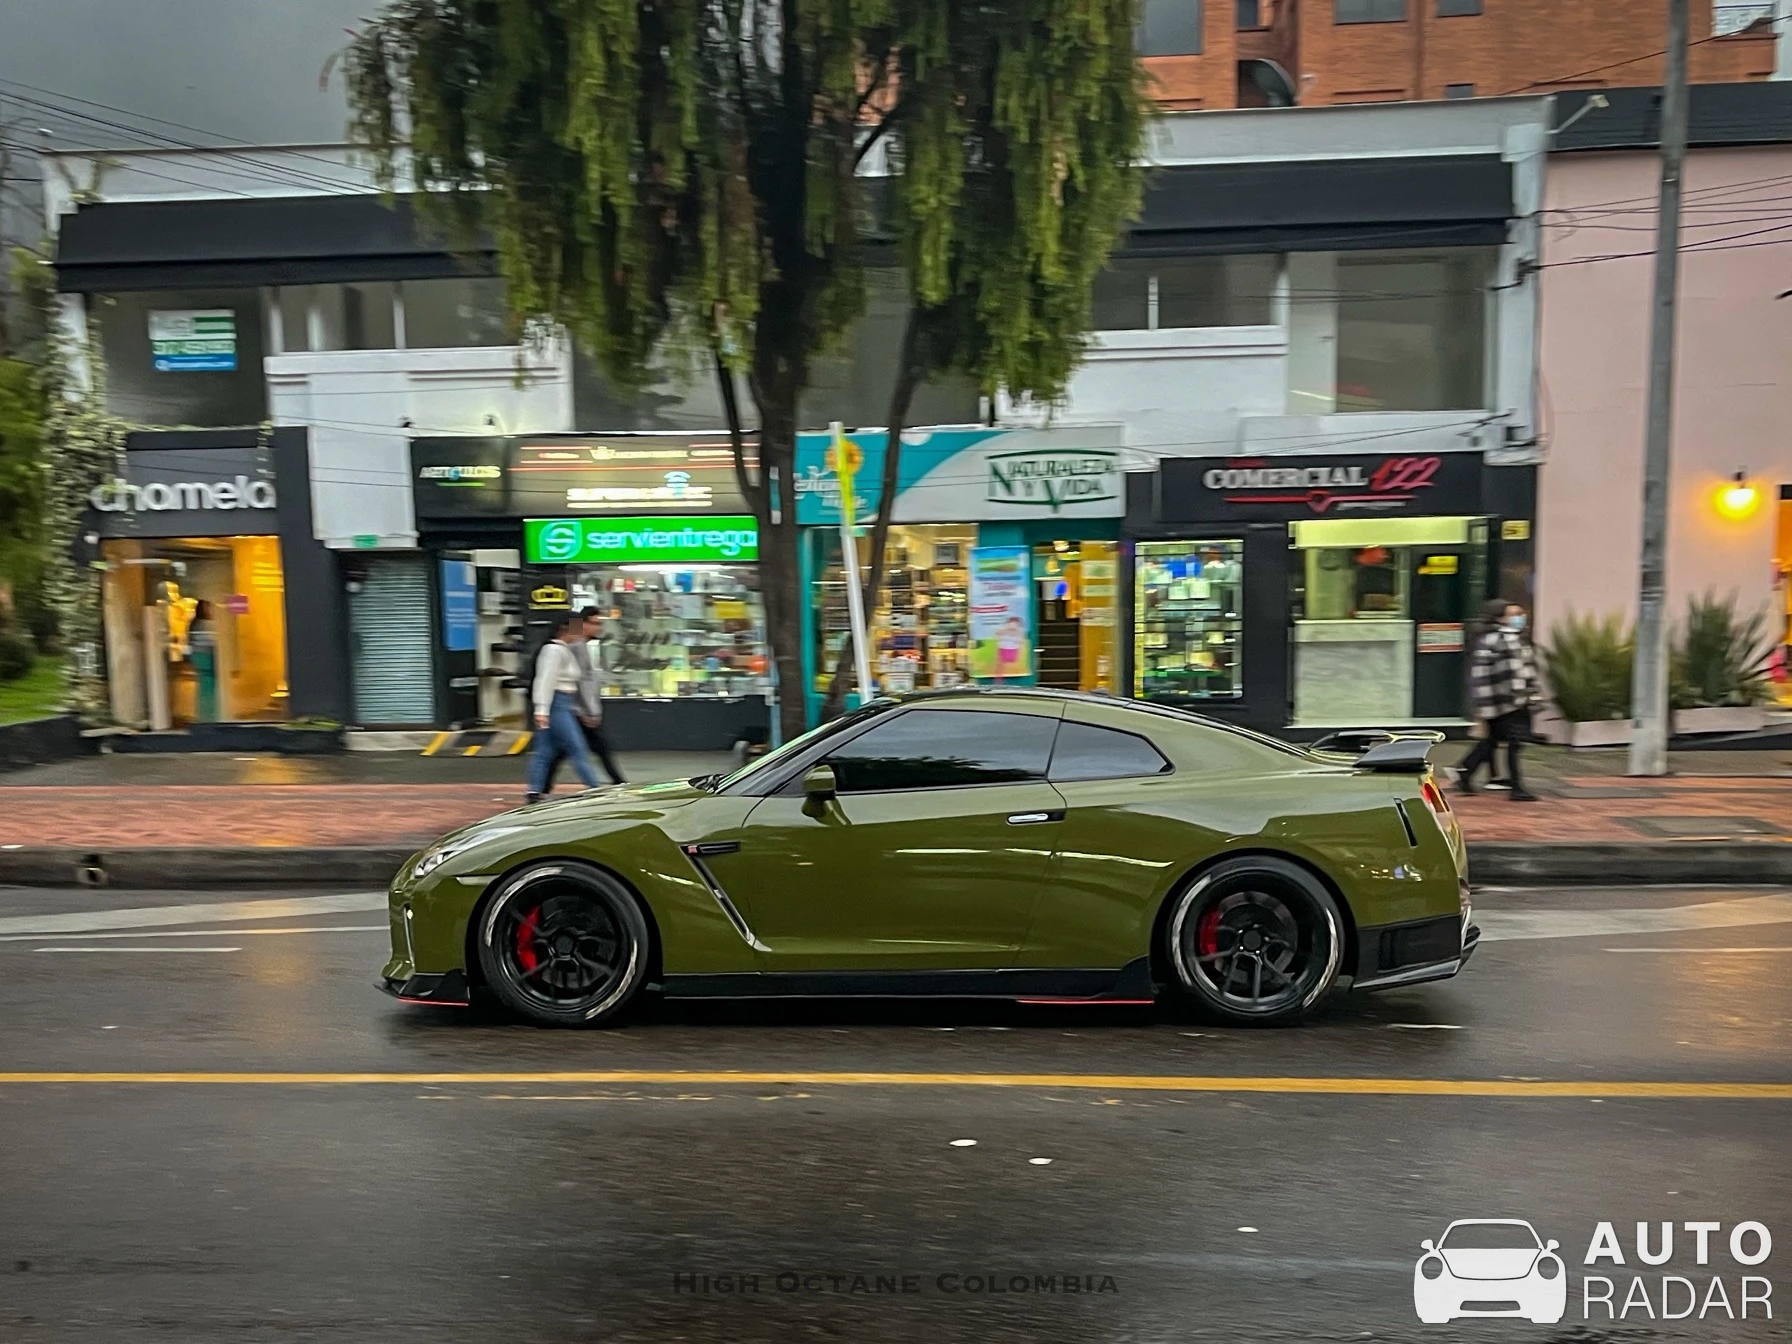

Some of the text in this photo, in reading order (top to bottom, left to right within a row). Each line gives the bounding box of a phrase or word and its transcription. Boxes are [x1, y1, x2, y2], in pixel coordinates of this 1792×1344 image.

[1203, 466, 1369, 489] COMERCIAL
[1042, 479, 1106, 514] VIDA
[587, 527, 758, 556] servientrega
